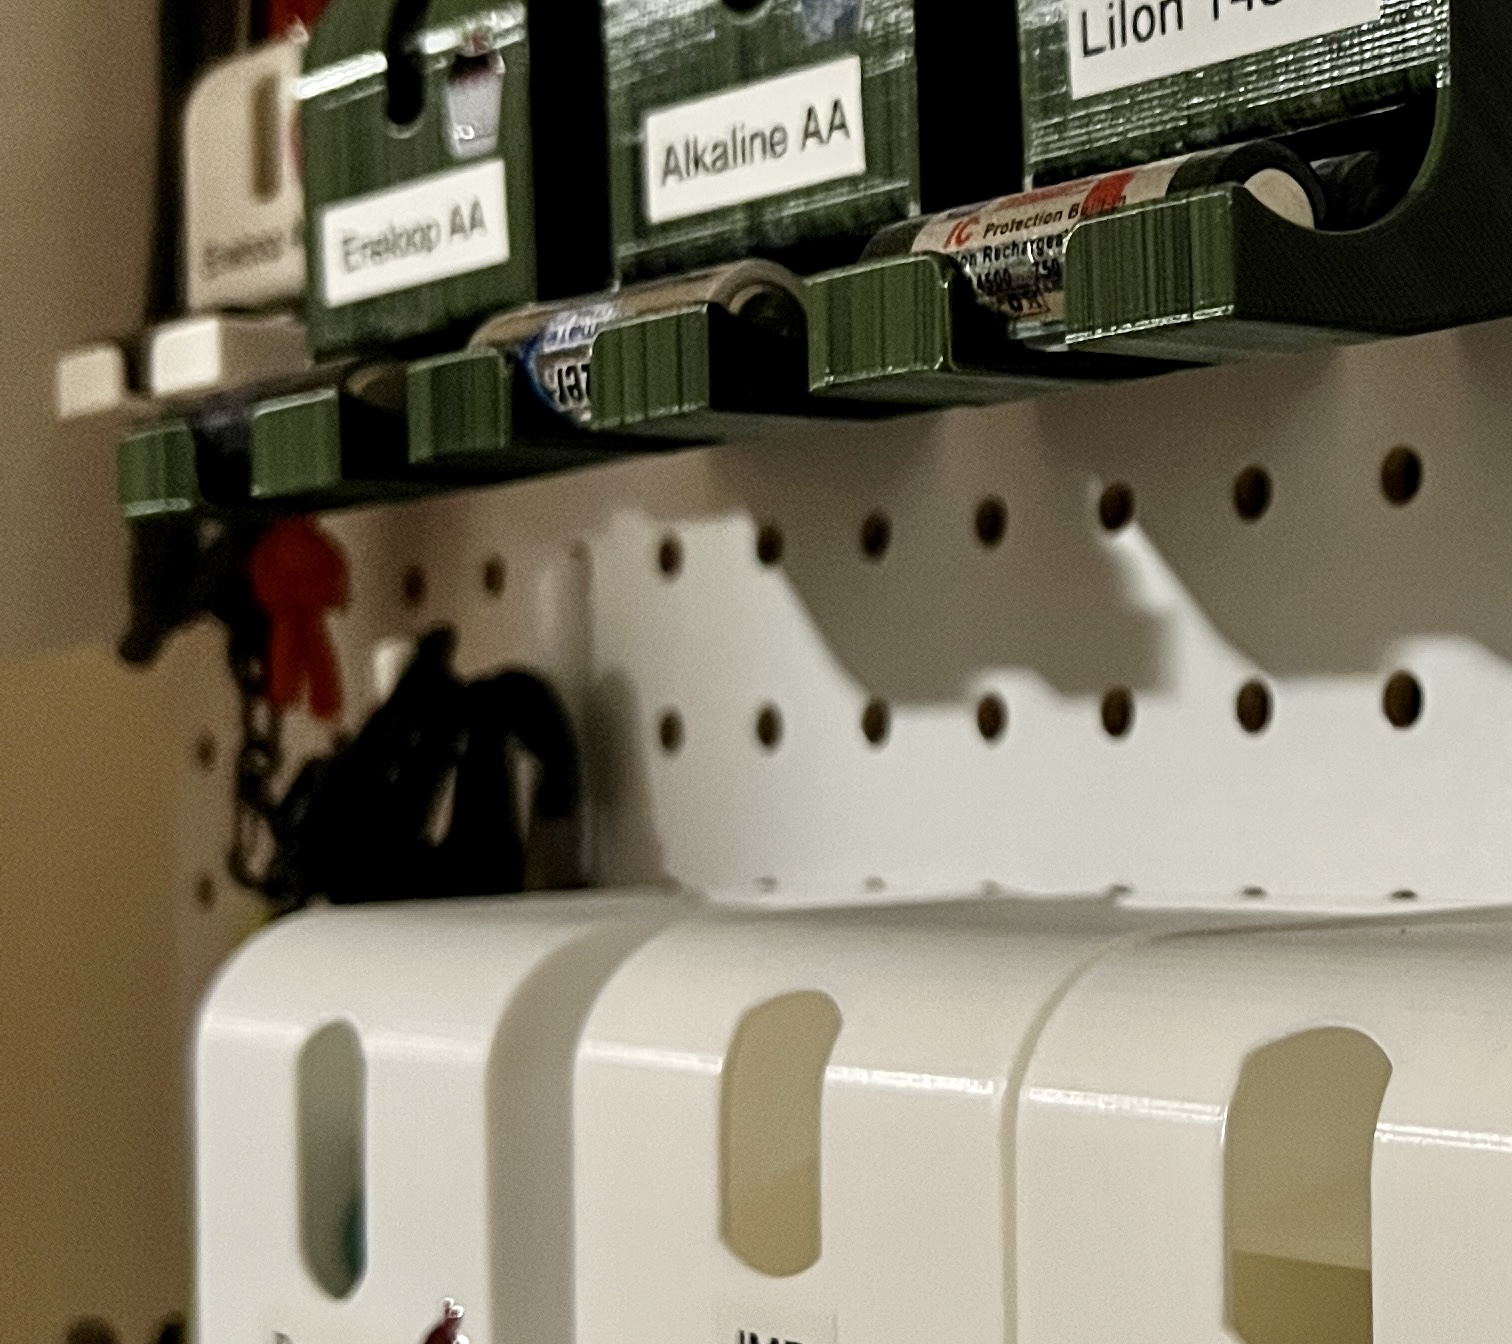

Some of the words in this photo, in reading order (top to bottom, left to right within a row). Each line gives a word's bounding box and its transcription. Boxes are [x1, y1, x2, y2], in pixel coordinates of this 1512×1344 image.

[660, 122, 788, 187] Alkaline
[801, 99, 851, 150] AA
[448, 196, 488, 240] AA
[982, 208, 1063, 240] Protection
